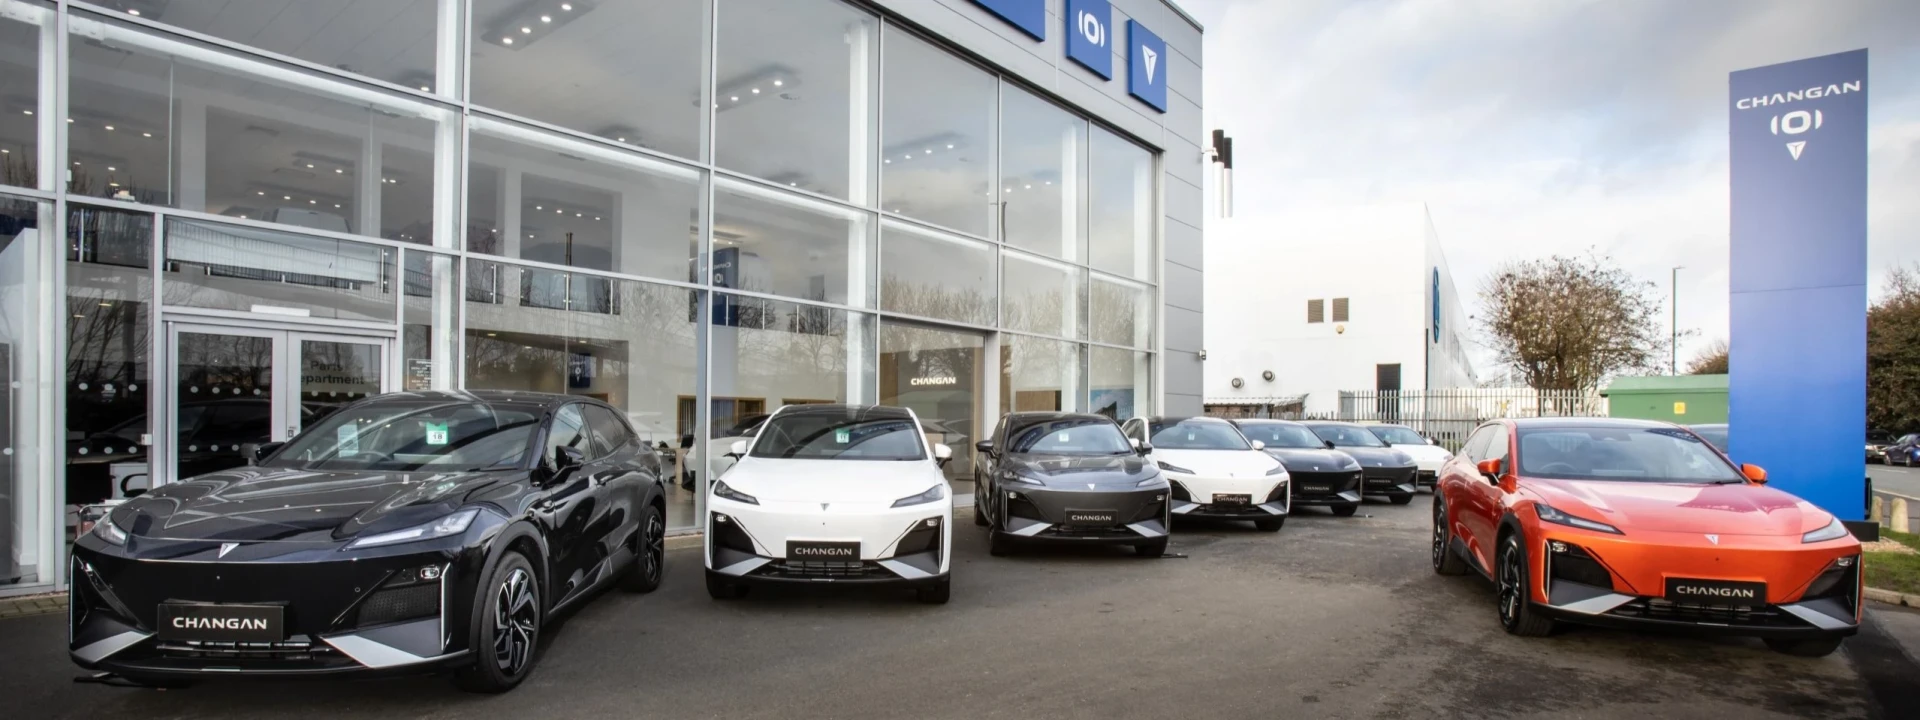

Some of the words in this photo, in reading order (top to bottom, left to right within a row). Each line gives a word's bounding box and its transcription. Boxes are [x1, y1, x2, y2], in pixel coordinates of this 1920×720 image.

[1736, 80, 1861, 110] CHANGAN
[310, 360, 343, 372] Parts
[301, 374, 364, 385] epartment
[910, 377, 956, 386] CHANGAN
[795, 547, 852, 556] CHANGAN
[1676, 585, 1755, 598] CHANGAN
[172, 616, 268, 630] CHANGAN
